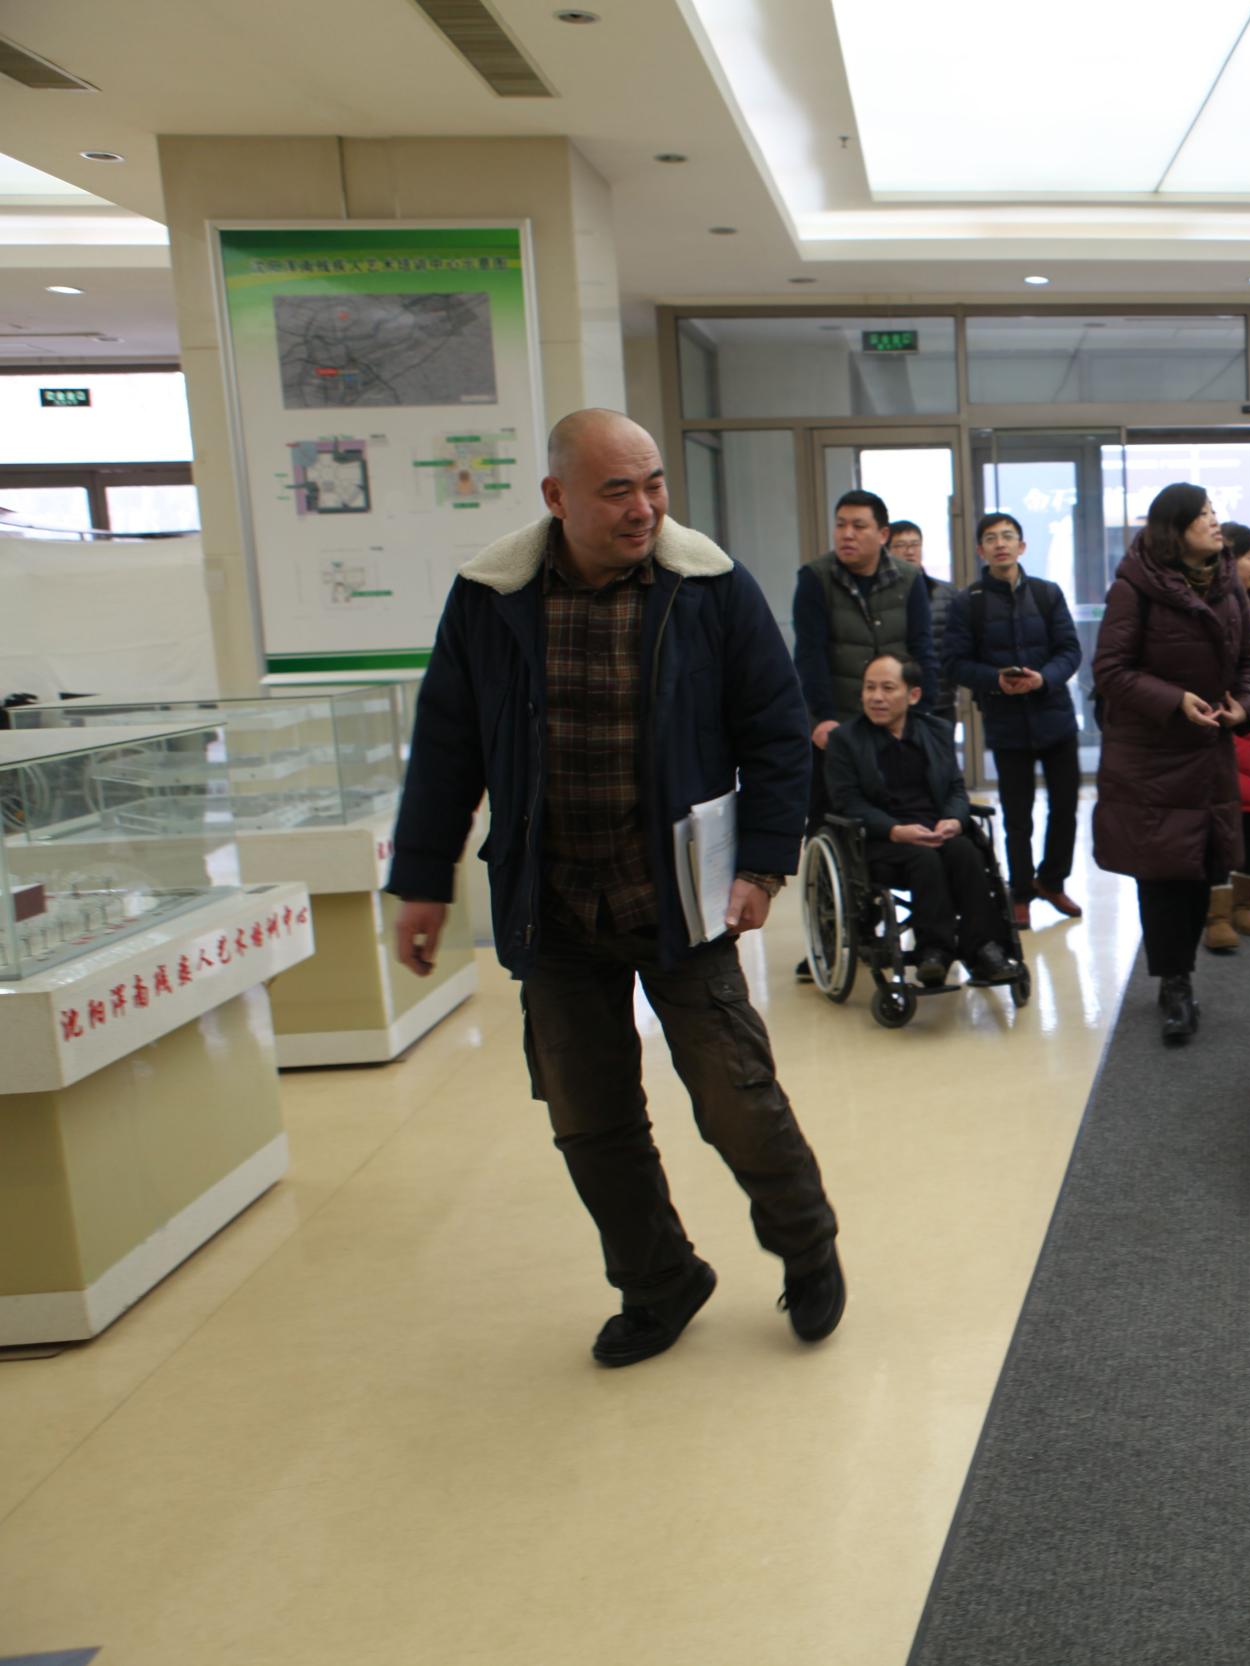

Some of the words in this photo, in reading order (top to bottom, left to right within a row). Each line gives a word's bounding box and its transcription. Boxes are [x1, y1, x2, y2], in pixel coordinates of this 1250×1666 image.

[61, 905, 307, 1041] 沈阳浑南残疾人艺术培训中心
